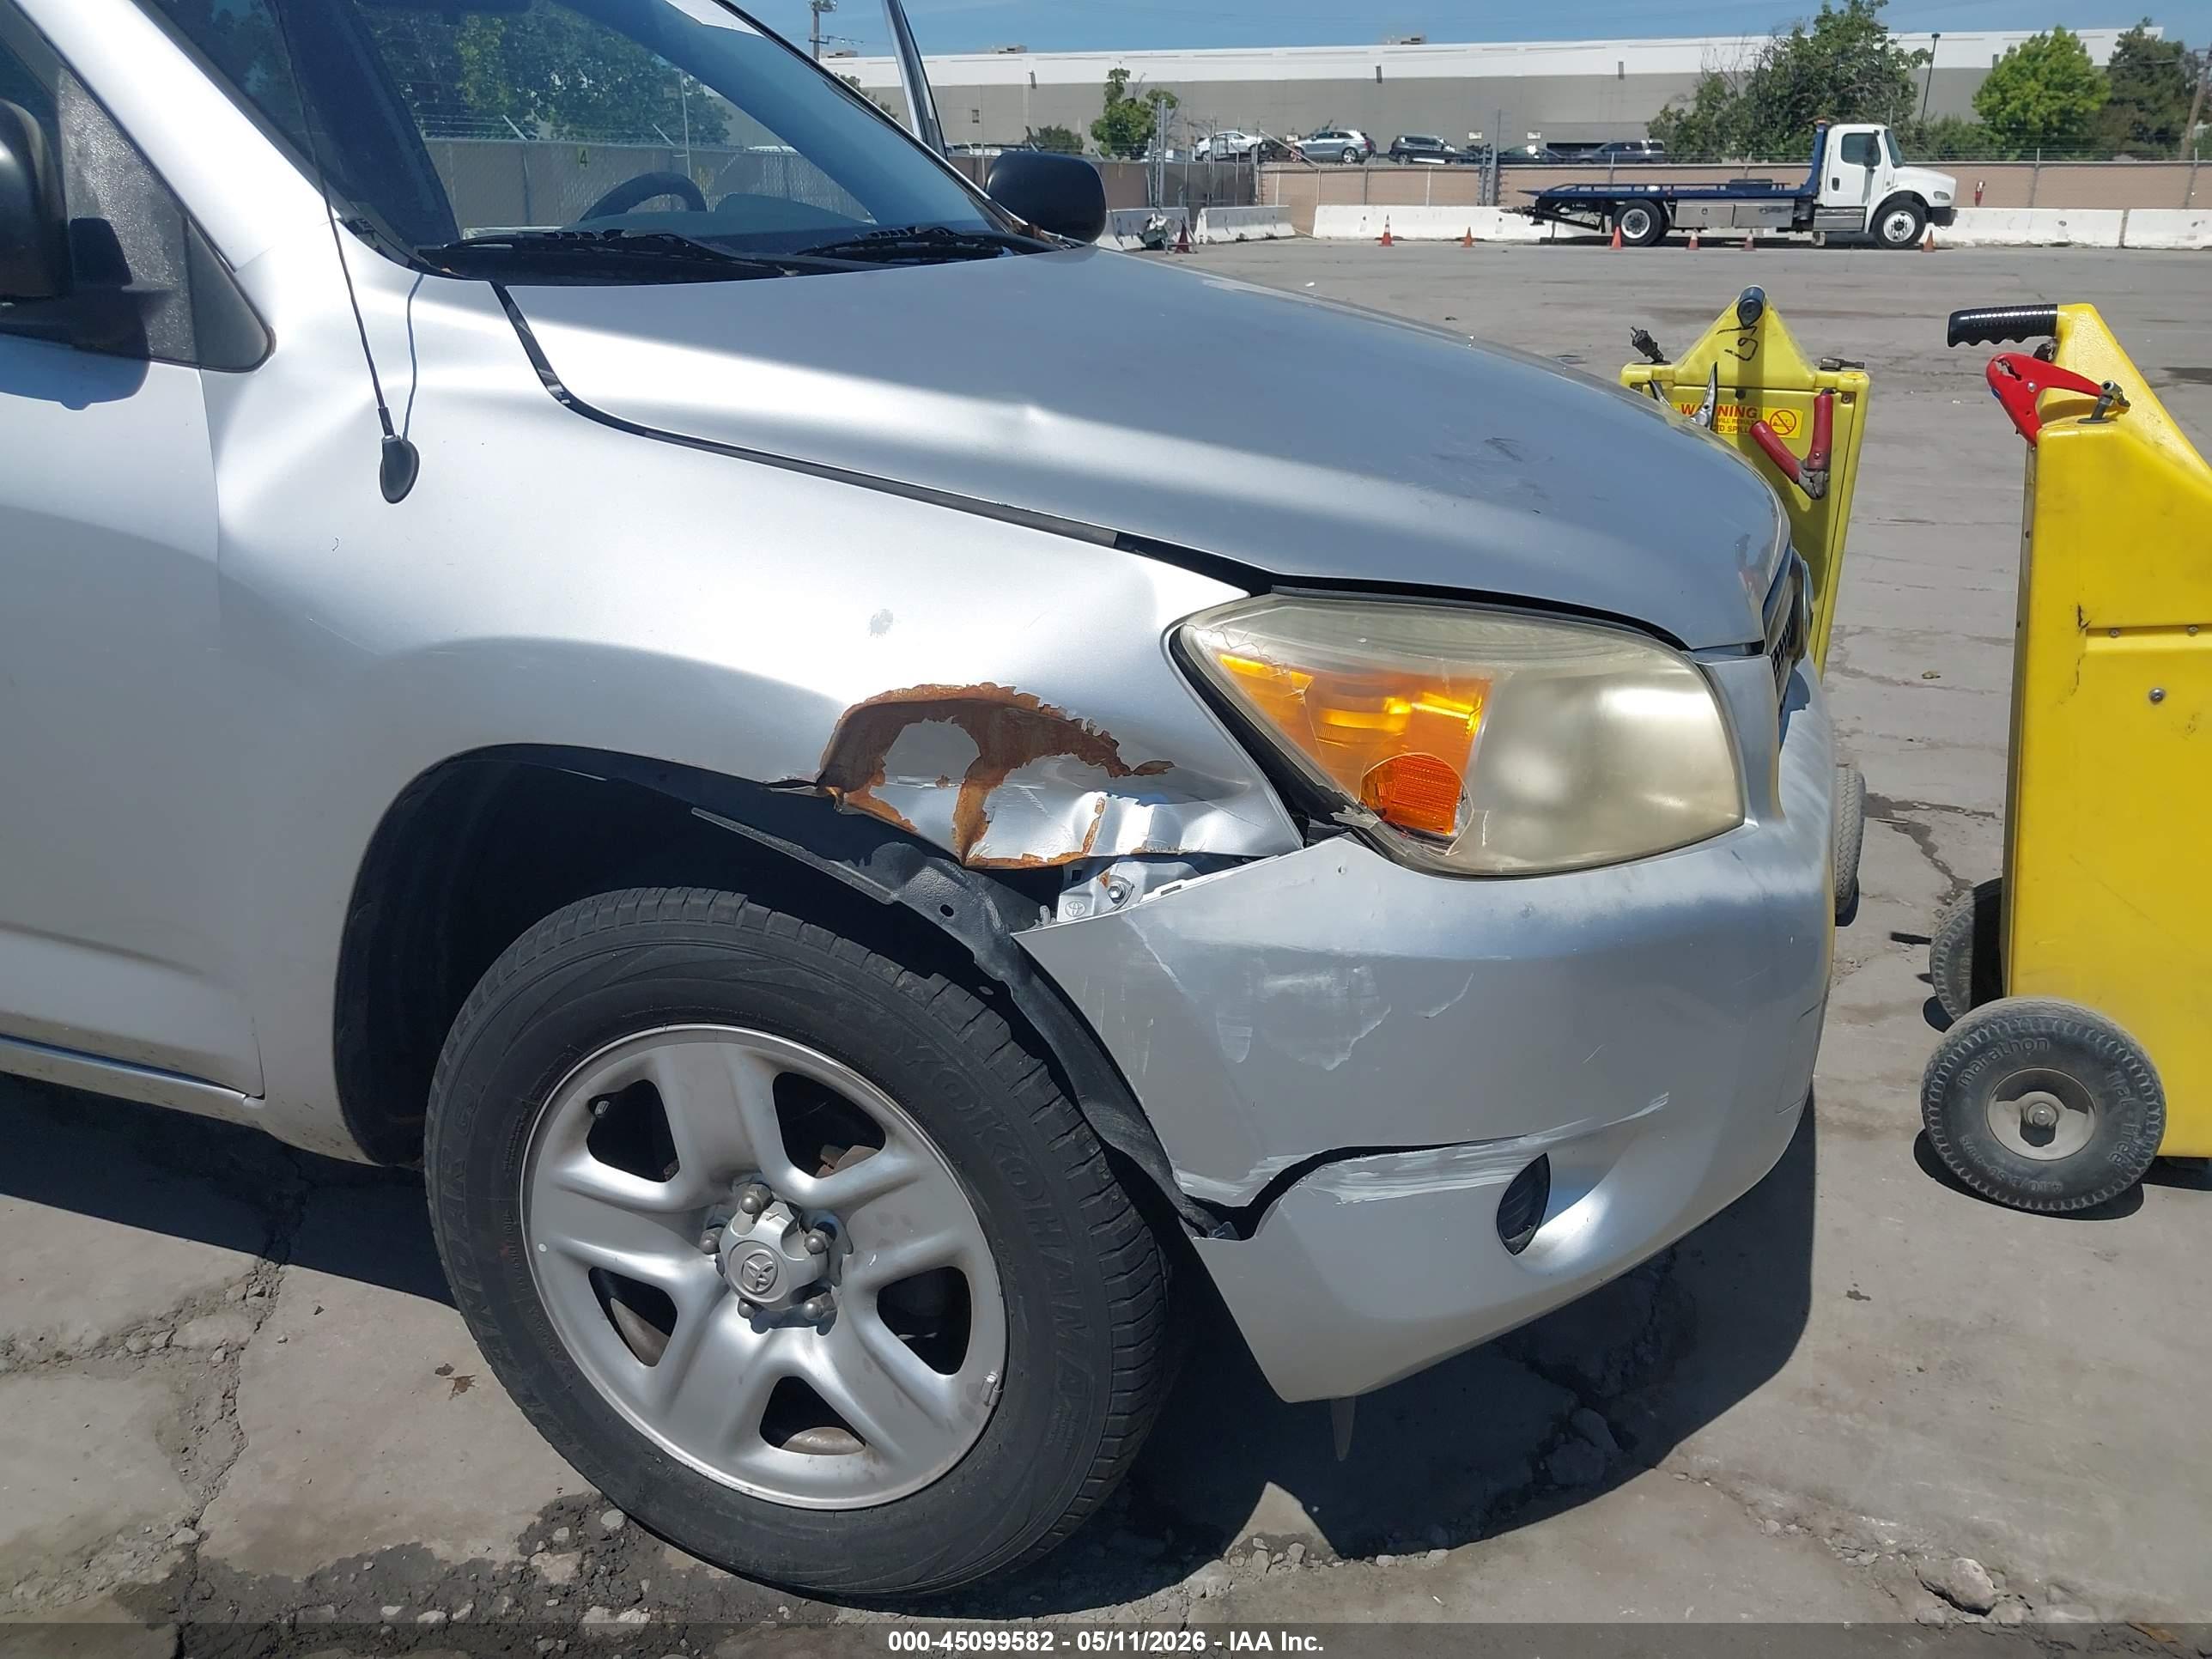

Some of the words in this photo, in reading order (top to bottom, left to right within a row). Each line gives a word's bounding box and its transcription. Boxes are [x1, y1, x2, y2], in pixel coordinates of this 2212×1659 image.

[579, 149, 589, 168] 4
[1680, 404, 1758, 419] WNING
[1958, 1037, 2049, 1086] marathon
[893, 1035, 1091, 1398] YOKOHAMA
